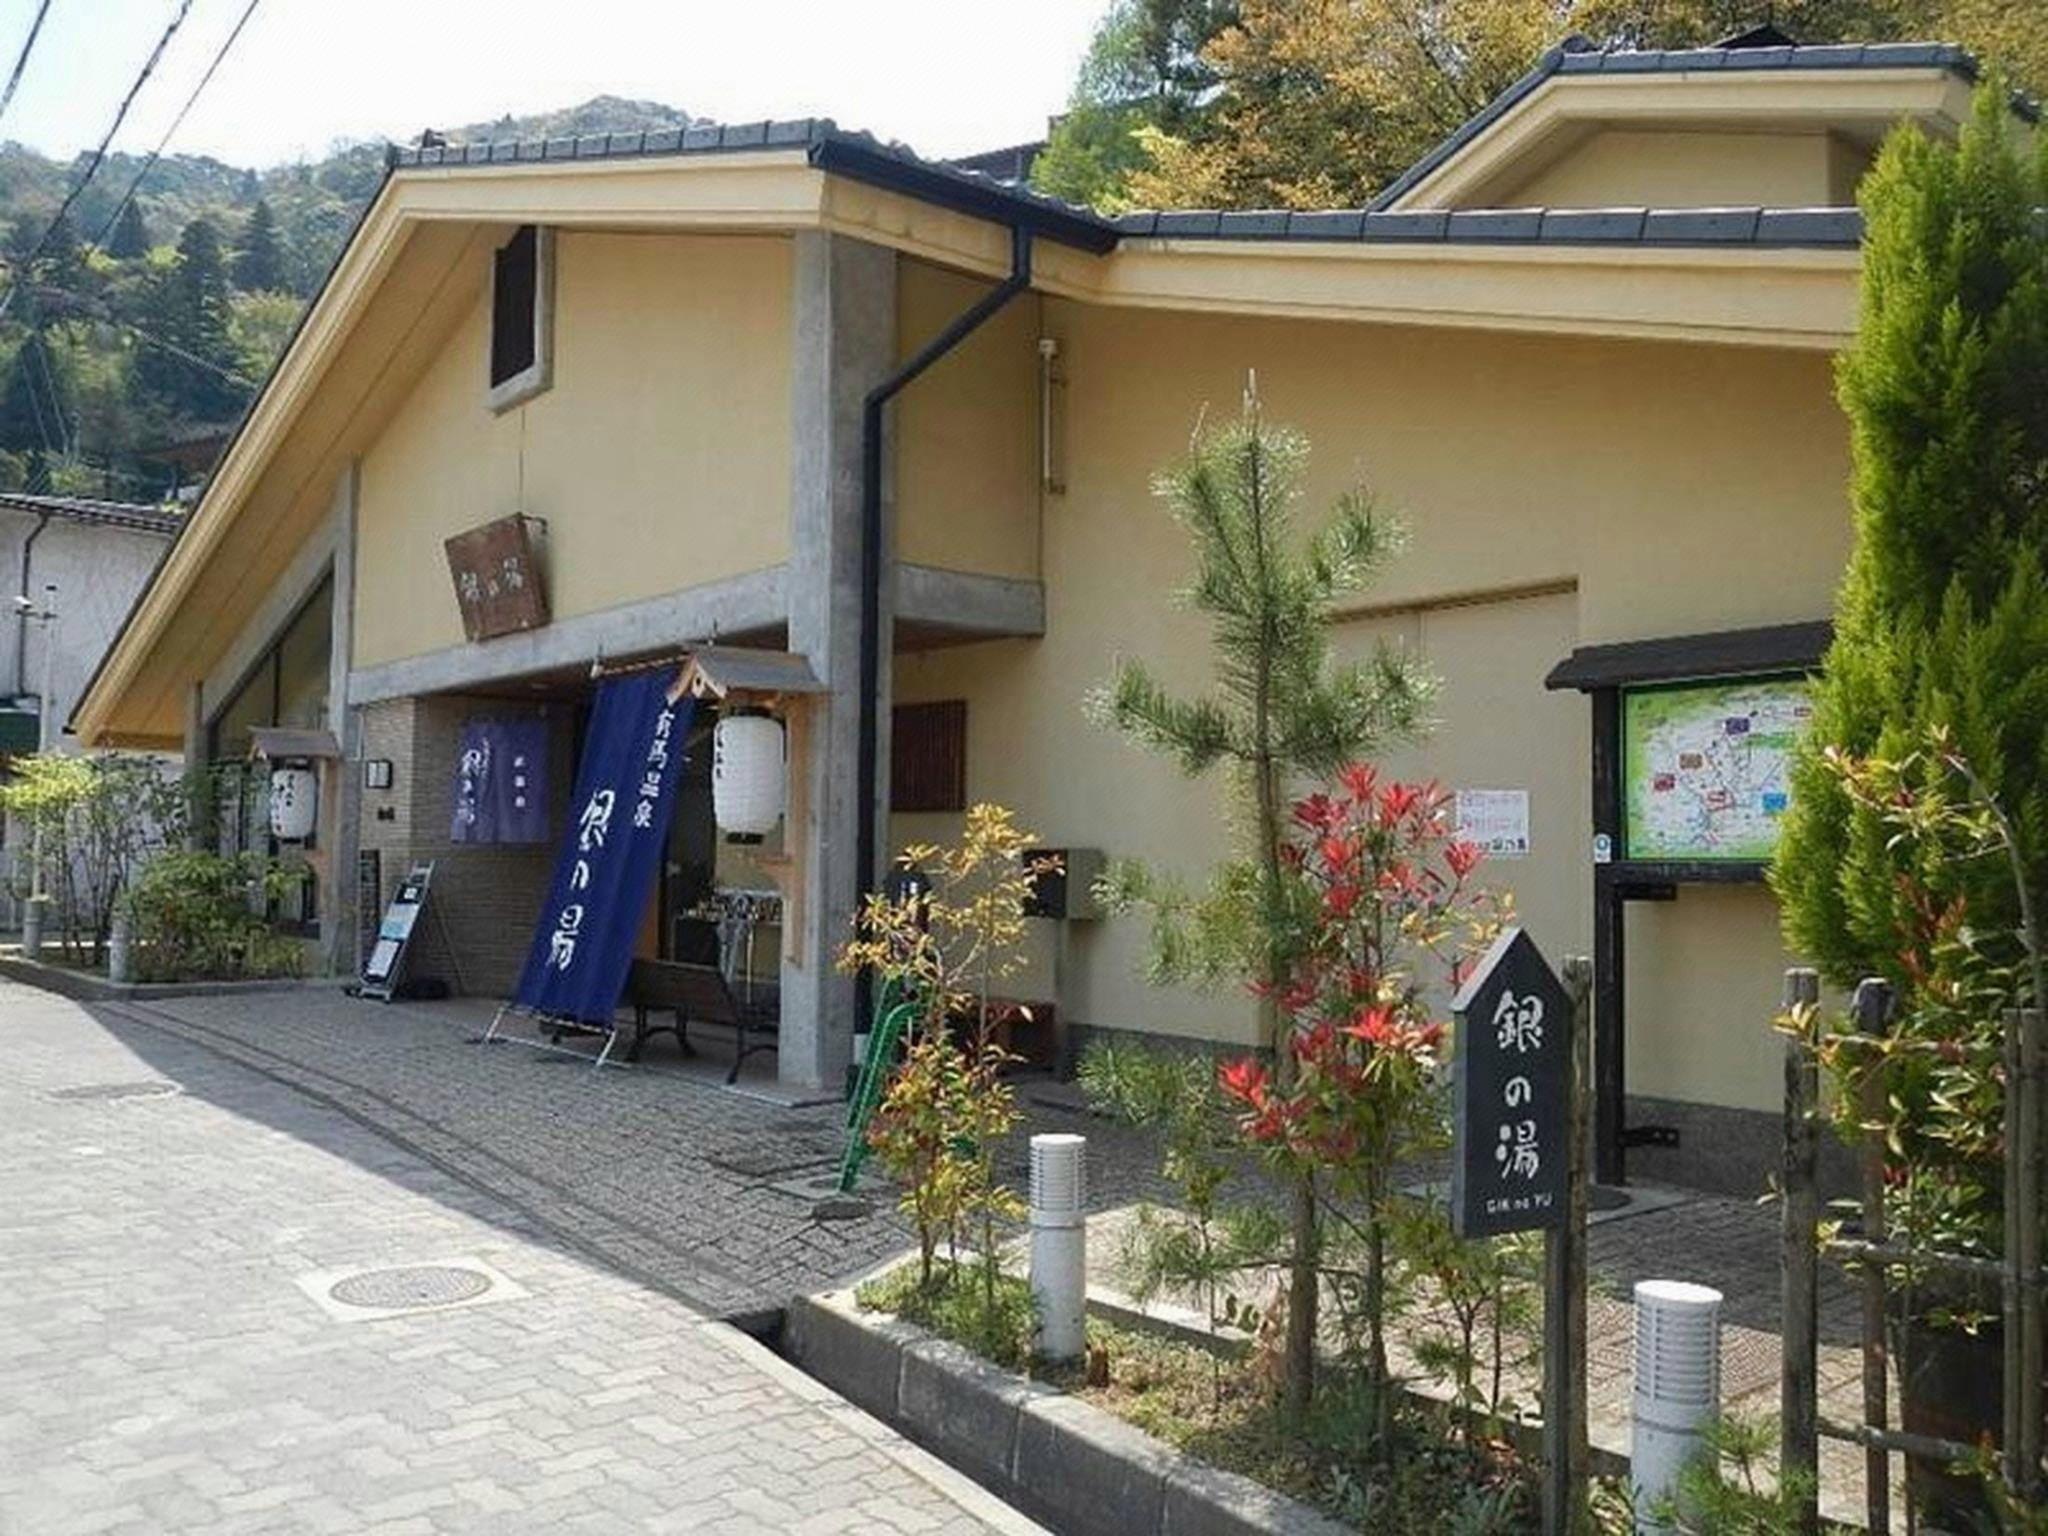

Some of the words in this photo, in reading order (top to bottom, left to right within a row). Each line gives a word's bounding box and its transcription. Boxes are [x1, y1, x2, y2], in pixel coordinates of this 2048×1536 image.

[1492, 989, 1544, 1179] 銀の湯
[1533, 1191, 1553, 1209] YU
